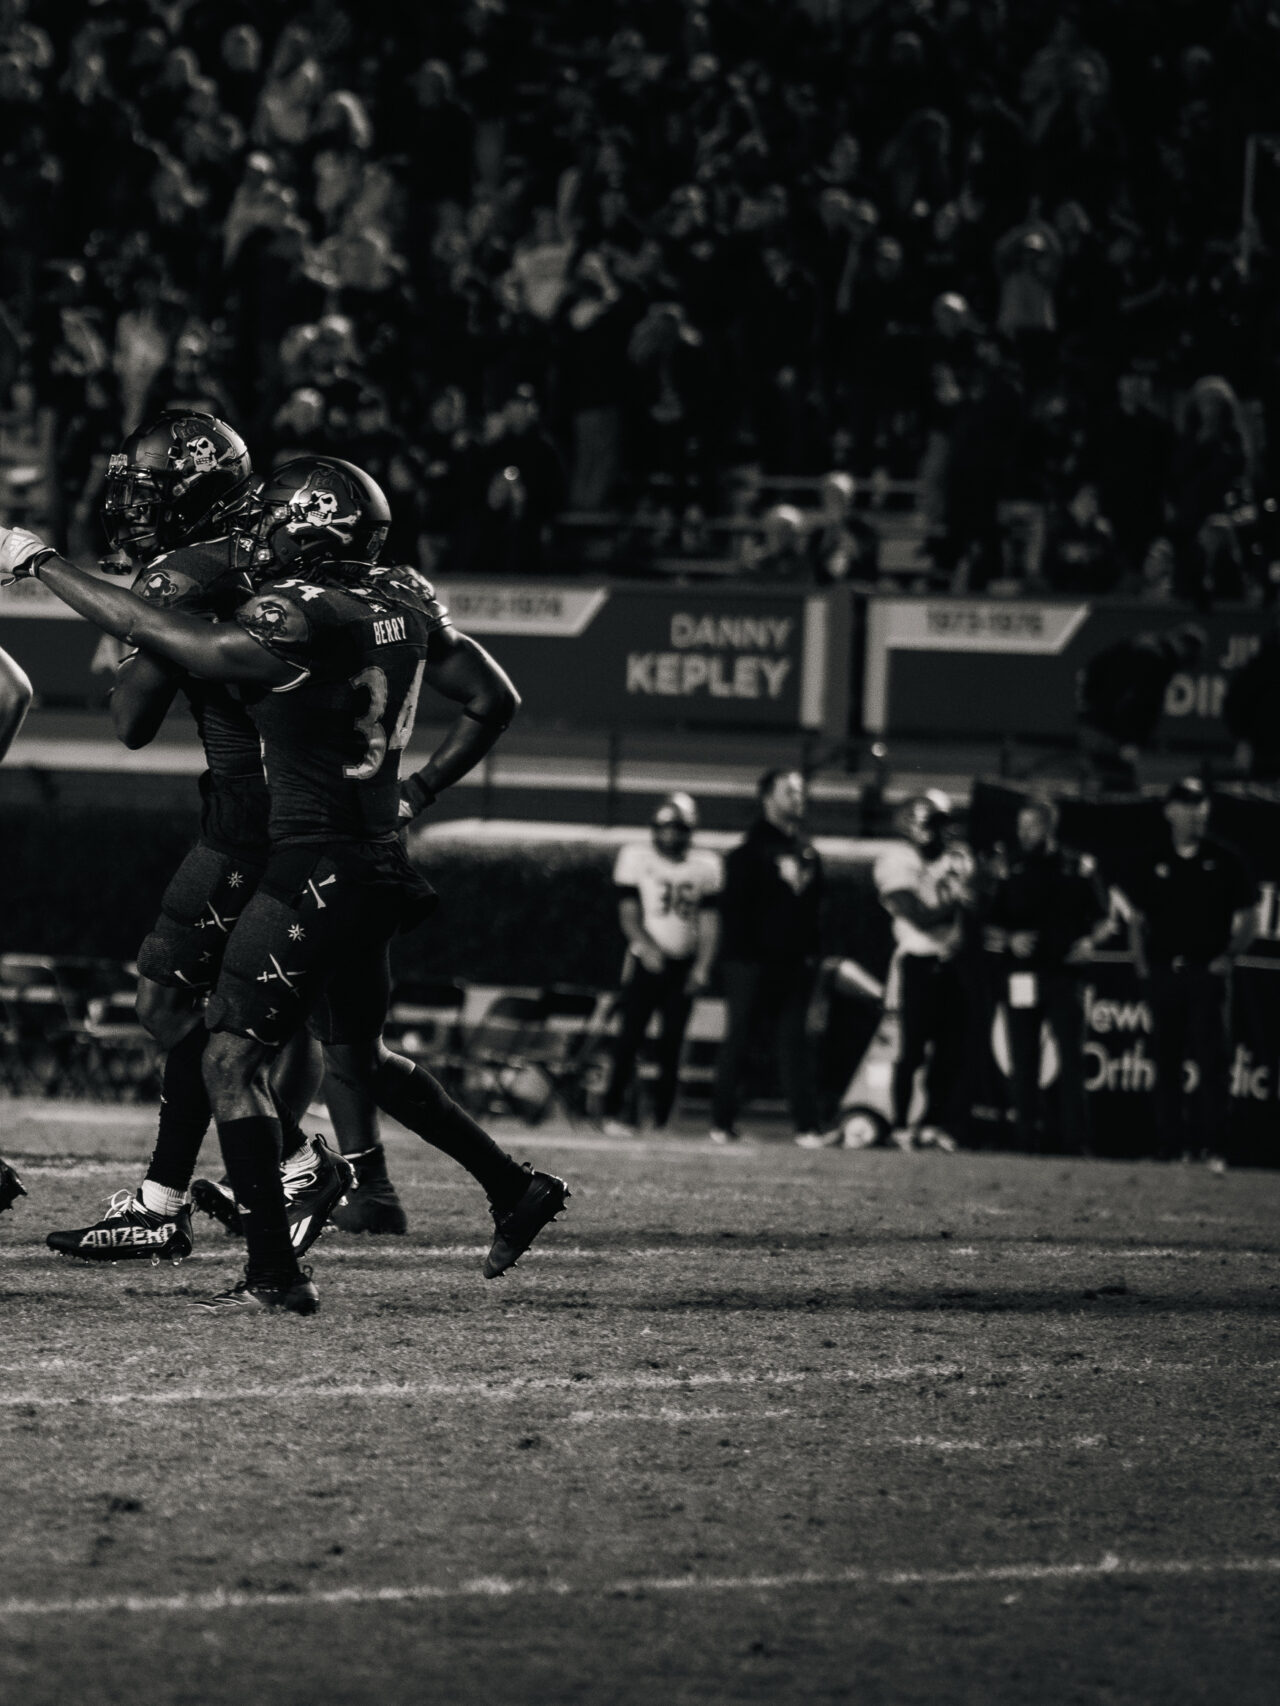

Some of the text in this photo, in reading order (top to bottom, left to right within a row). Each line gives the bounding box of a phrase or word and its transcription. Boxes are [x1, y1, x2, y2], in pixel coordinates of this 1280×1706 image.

[372, 616, 407, 646] BERRY
[670, 612, 793, 649] DANNY
[626, 652, 793, 699] KEPLEY
[341, 659, 428, 780] 34
